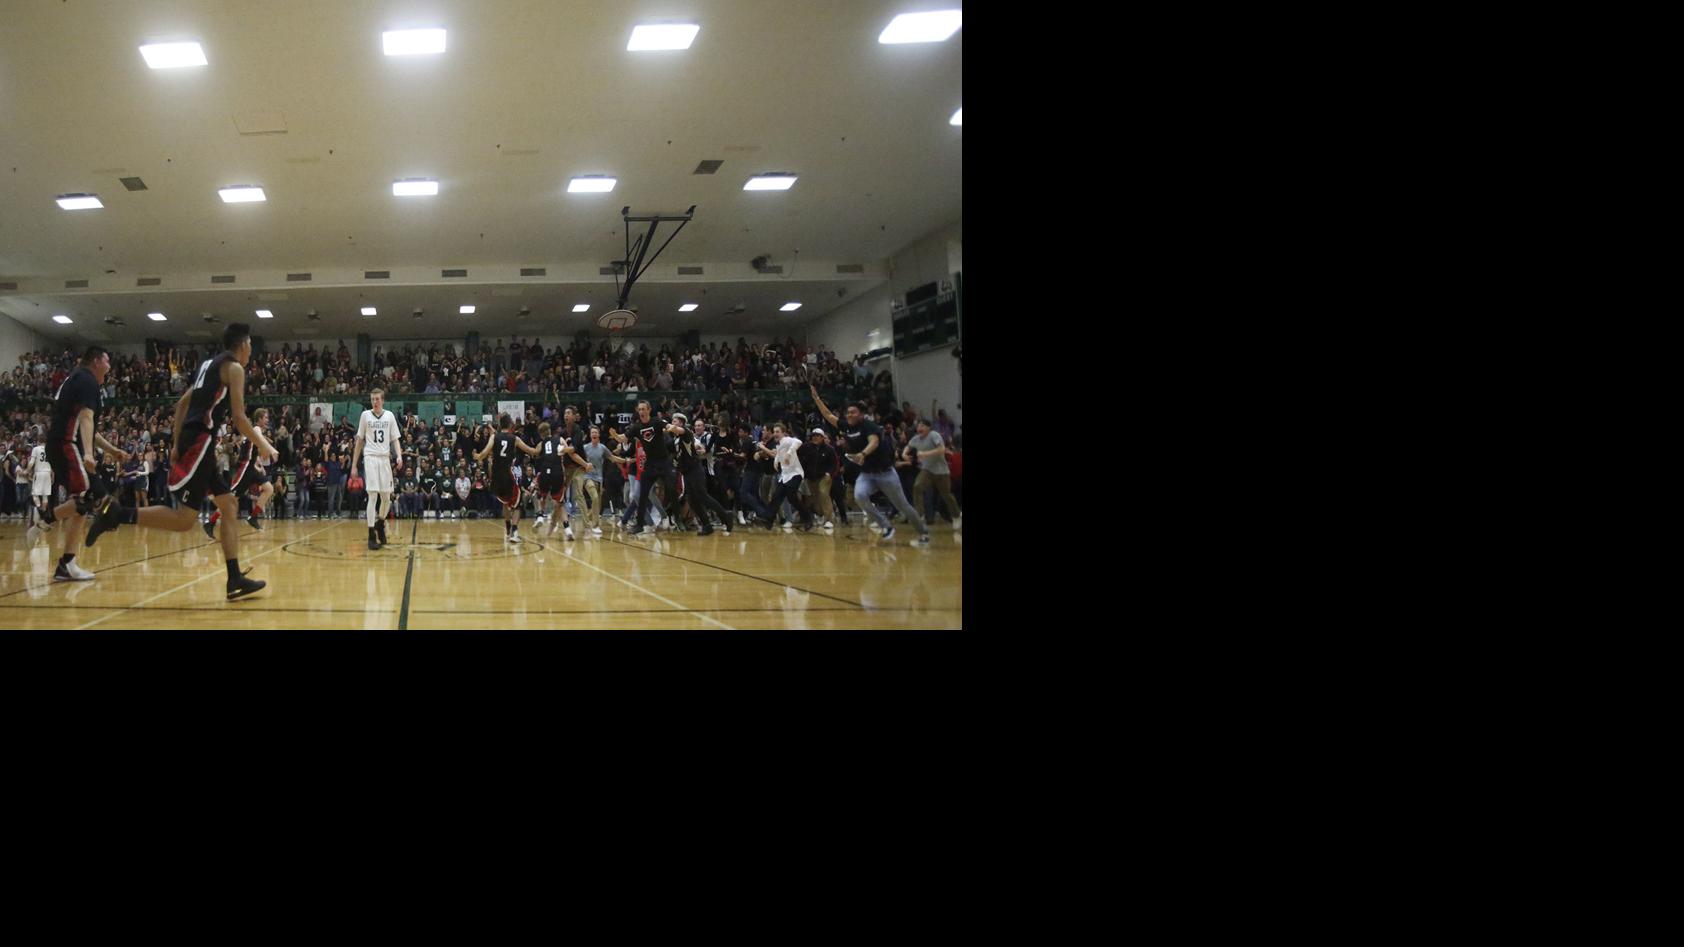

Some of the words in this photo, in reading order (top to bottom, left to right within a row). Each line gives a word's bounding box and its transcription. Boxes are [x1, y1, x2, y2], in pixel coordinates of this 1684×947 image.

[374, 430, 384, 443] 13
[500, 440, 508, 457] 2
[182, 490, 190, 503] C
